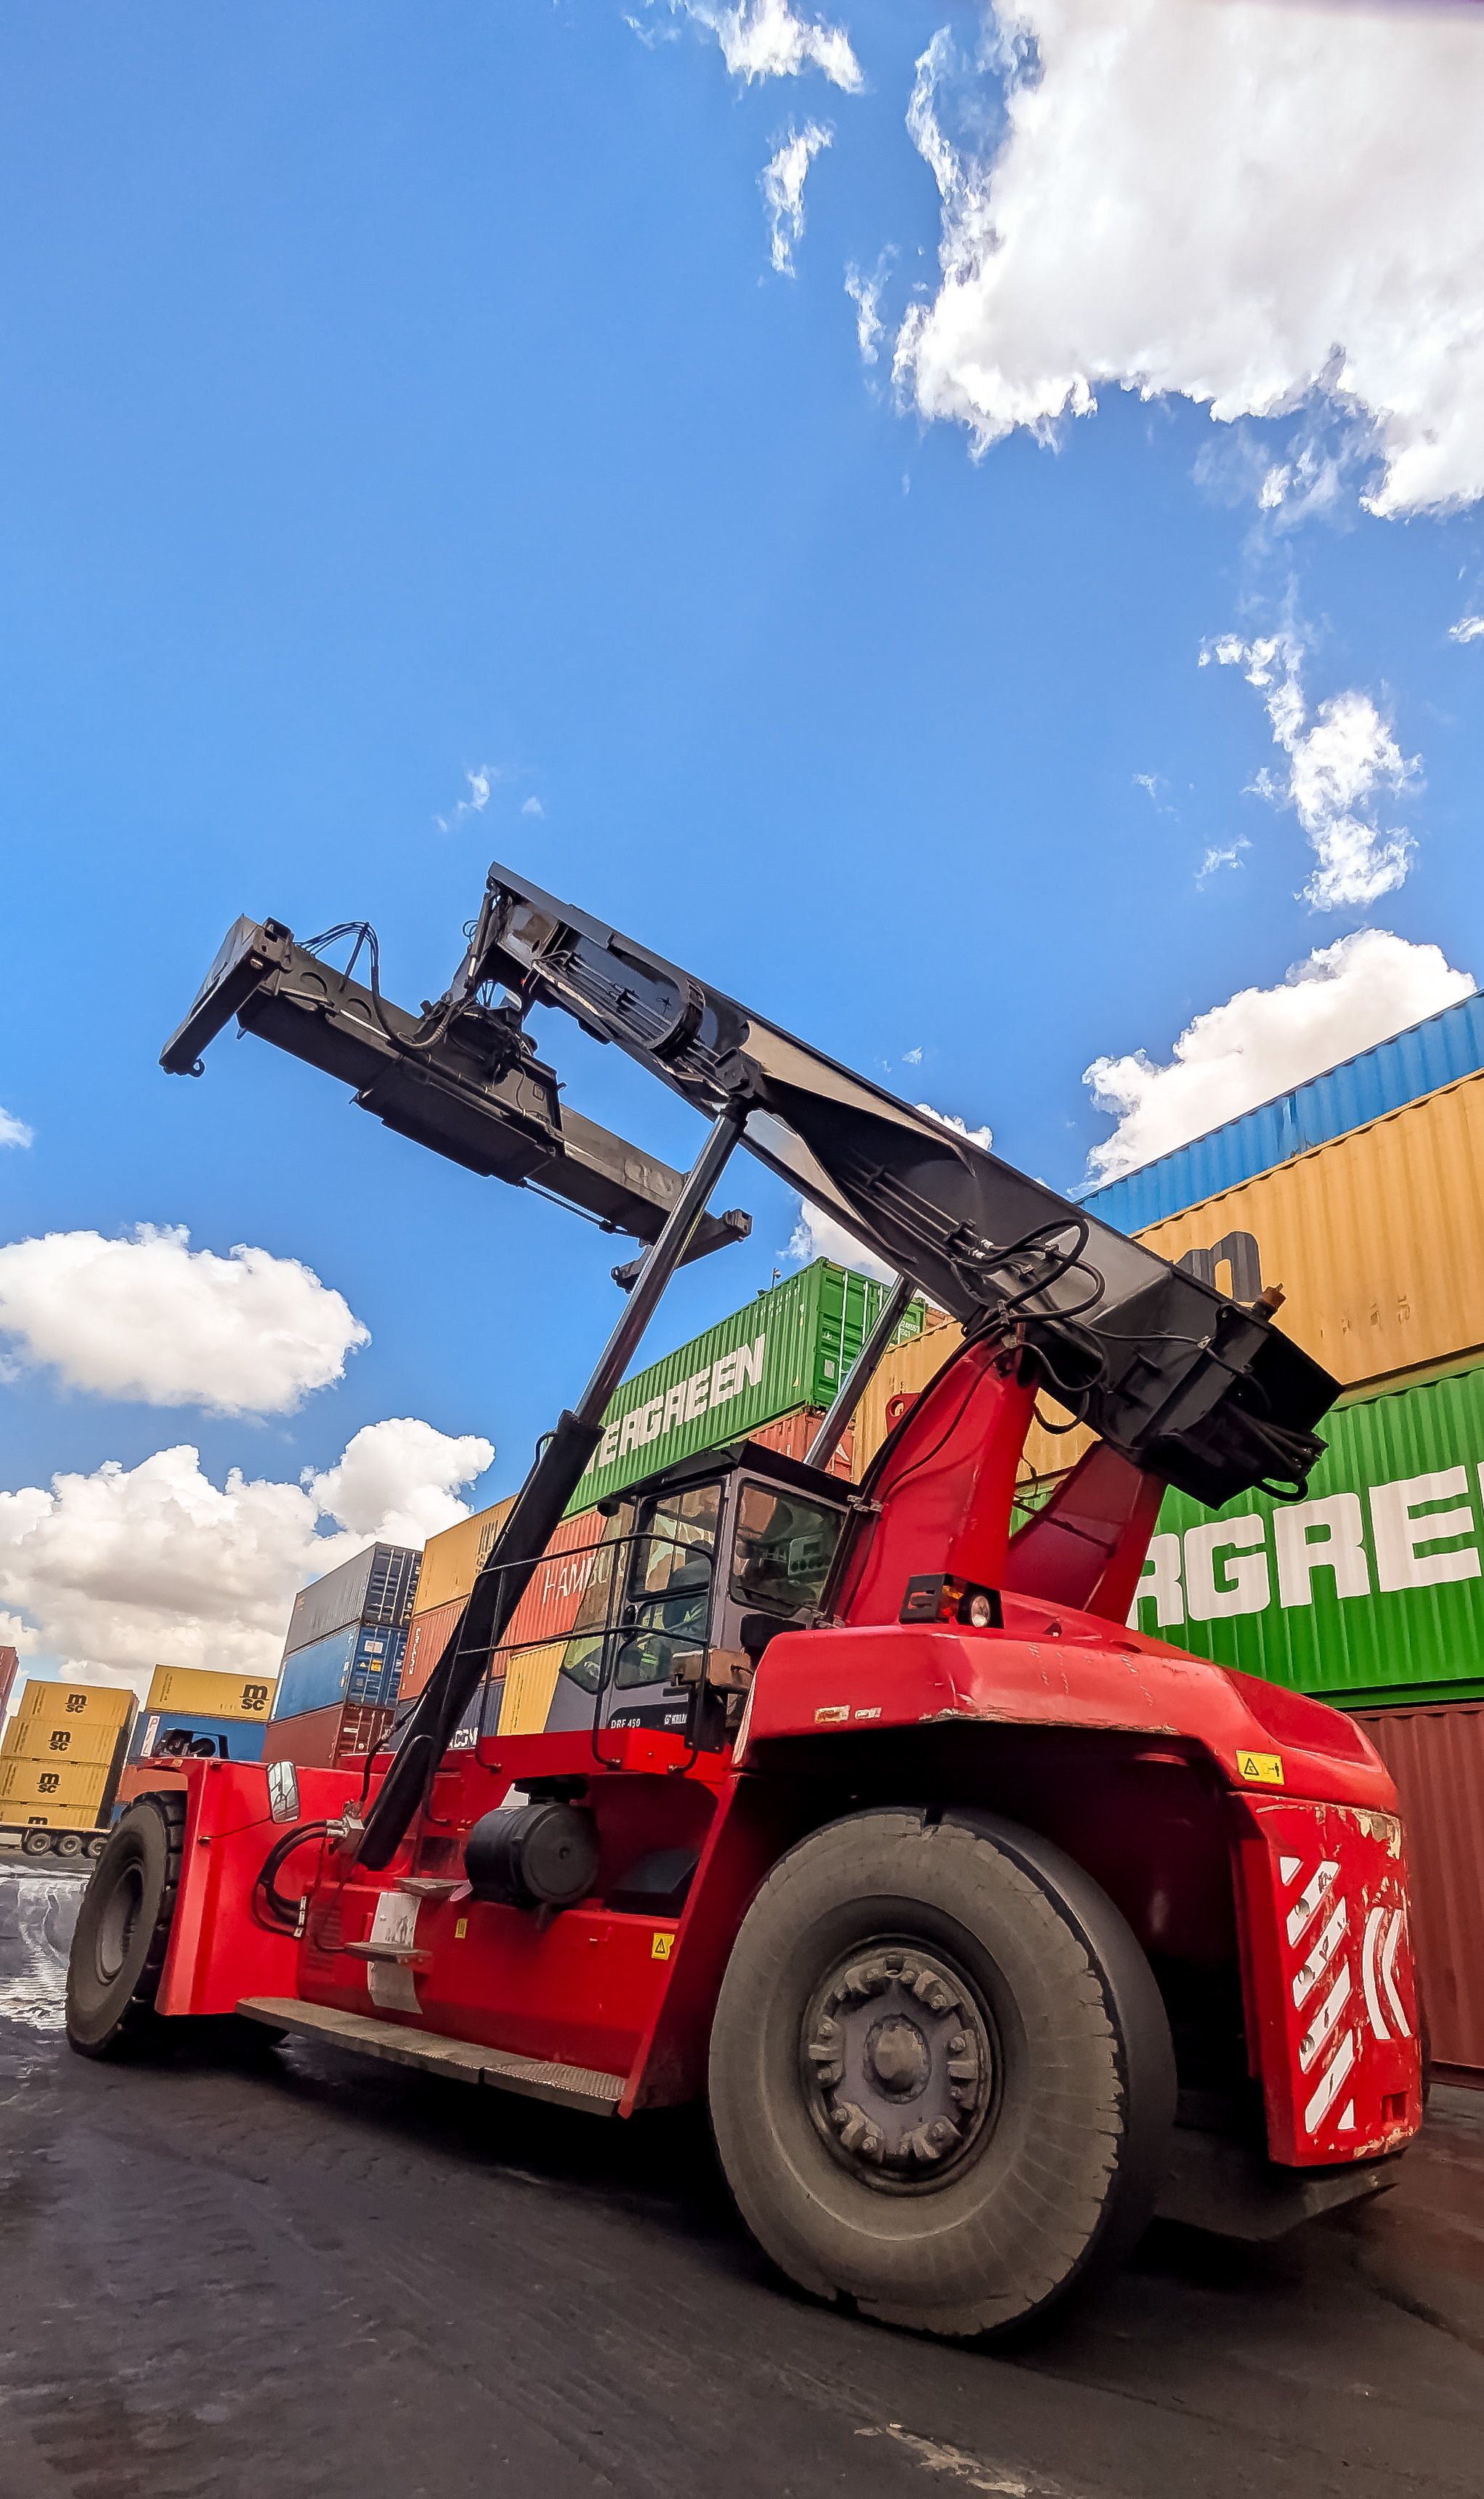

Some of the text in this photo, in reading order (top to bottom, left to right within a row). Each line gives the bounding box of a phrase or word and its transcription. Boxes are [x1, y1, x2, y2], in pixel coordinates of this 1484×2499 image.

[1126, 1462, 1484, 1631] RGRE
[610, 1718, 641, 1730] DRF 450
